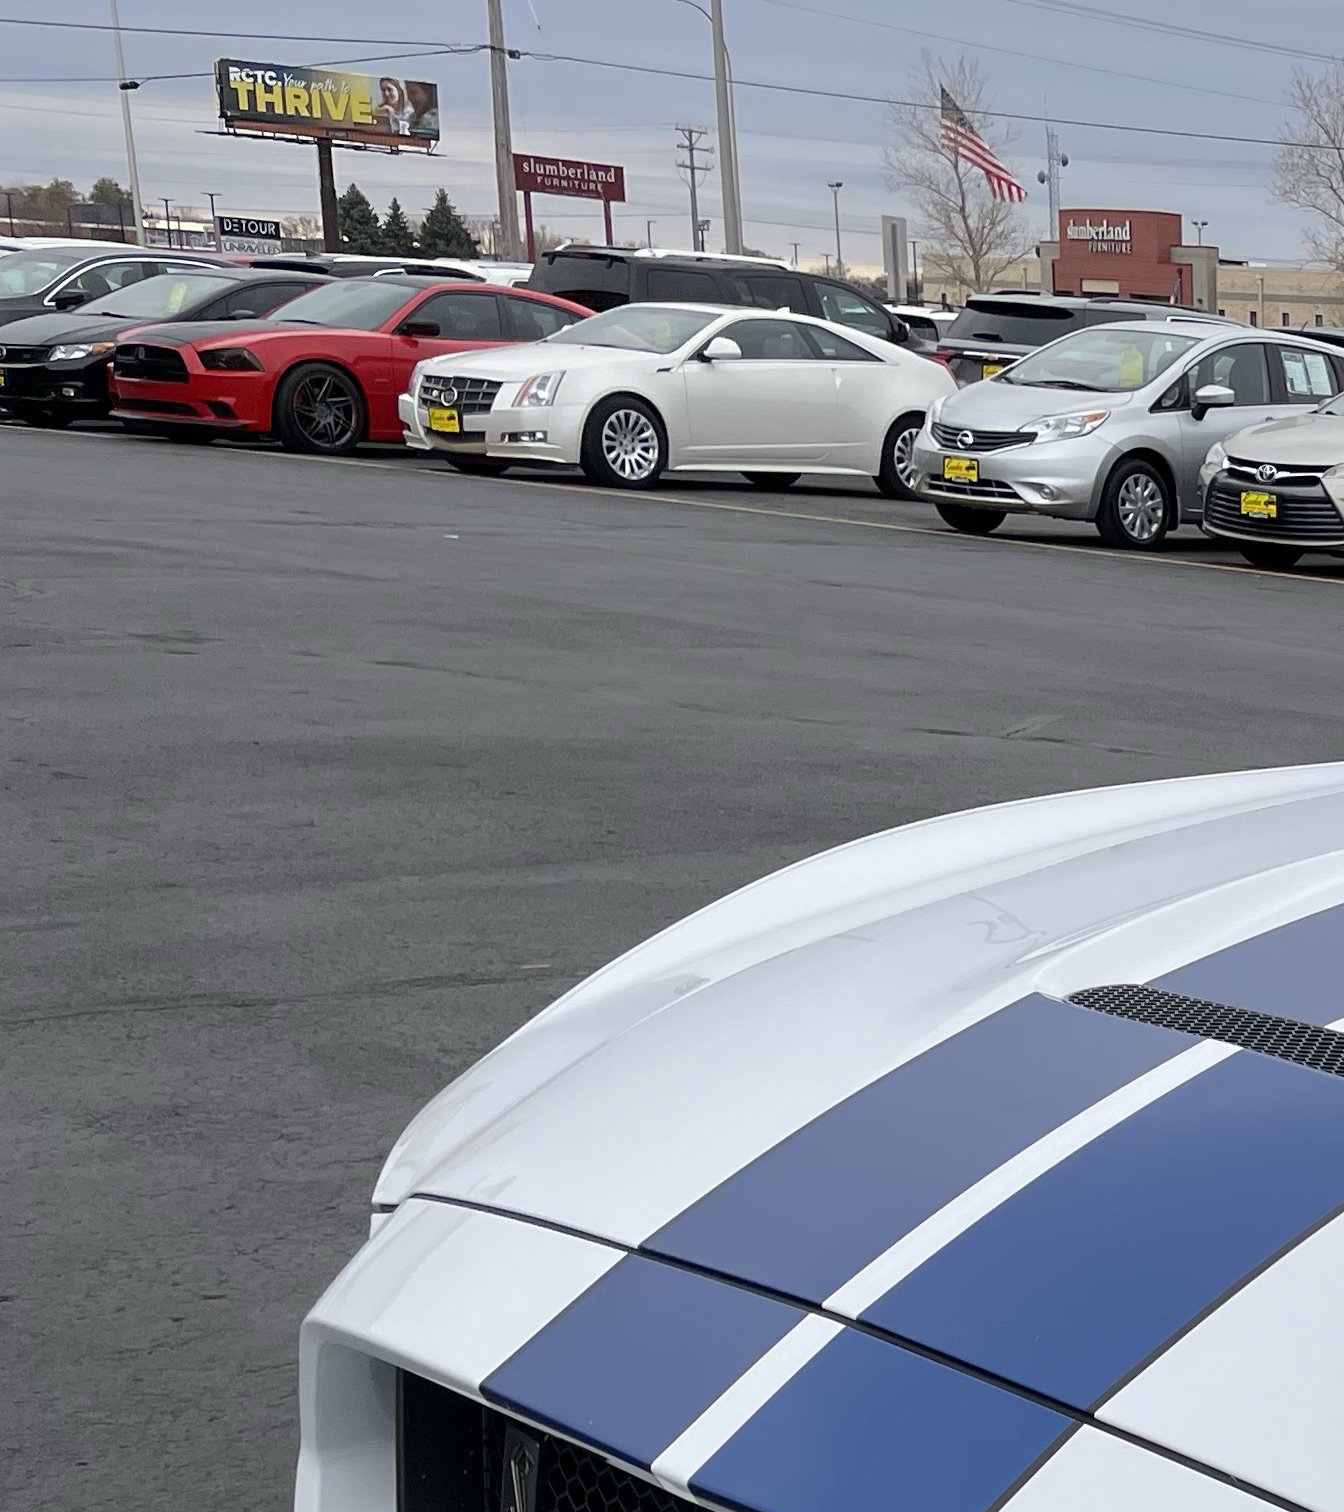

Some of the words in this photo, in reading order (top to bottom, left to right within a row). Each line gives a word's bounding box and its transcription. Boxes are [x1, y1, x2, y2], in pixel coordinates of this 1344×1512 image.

[229, 79, 377, 125] THRIVE.
[523, 158, 616, 183] slumberland
[536, 176, 603, 192] FURNITURE
[223, 217, 276, 235] DETOUR
[1088, 241, 1132, 255] FURNITURE
